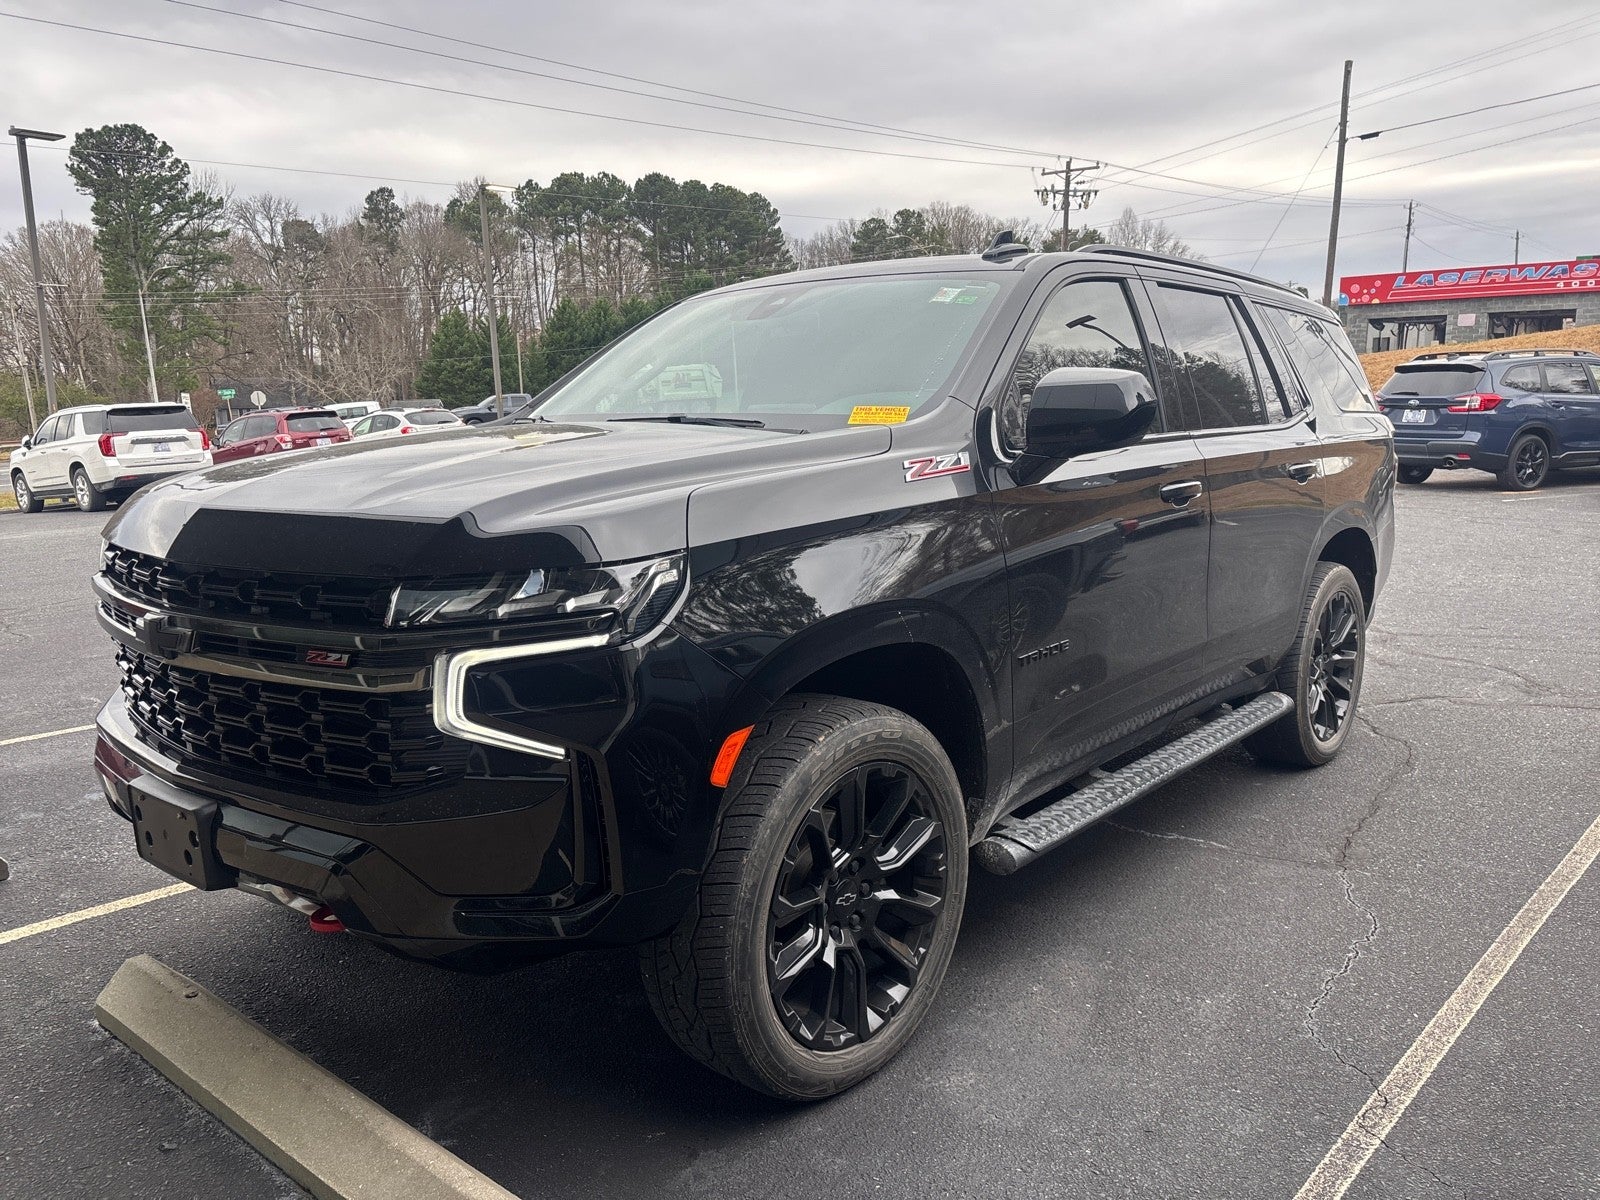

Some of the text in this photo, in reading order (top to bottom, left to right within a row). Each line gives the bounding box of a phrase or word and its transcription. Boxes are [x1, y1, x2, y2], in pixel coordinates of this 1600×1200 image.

[1393, 263, 1600, 289] LASERWAS
[903, 452, 971, 482] Z71
[305, 650, 350, 666] Z71
[1018, 639, 1070, 667] TAHOE
